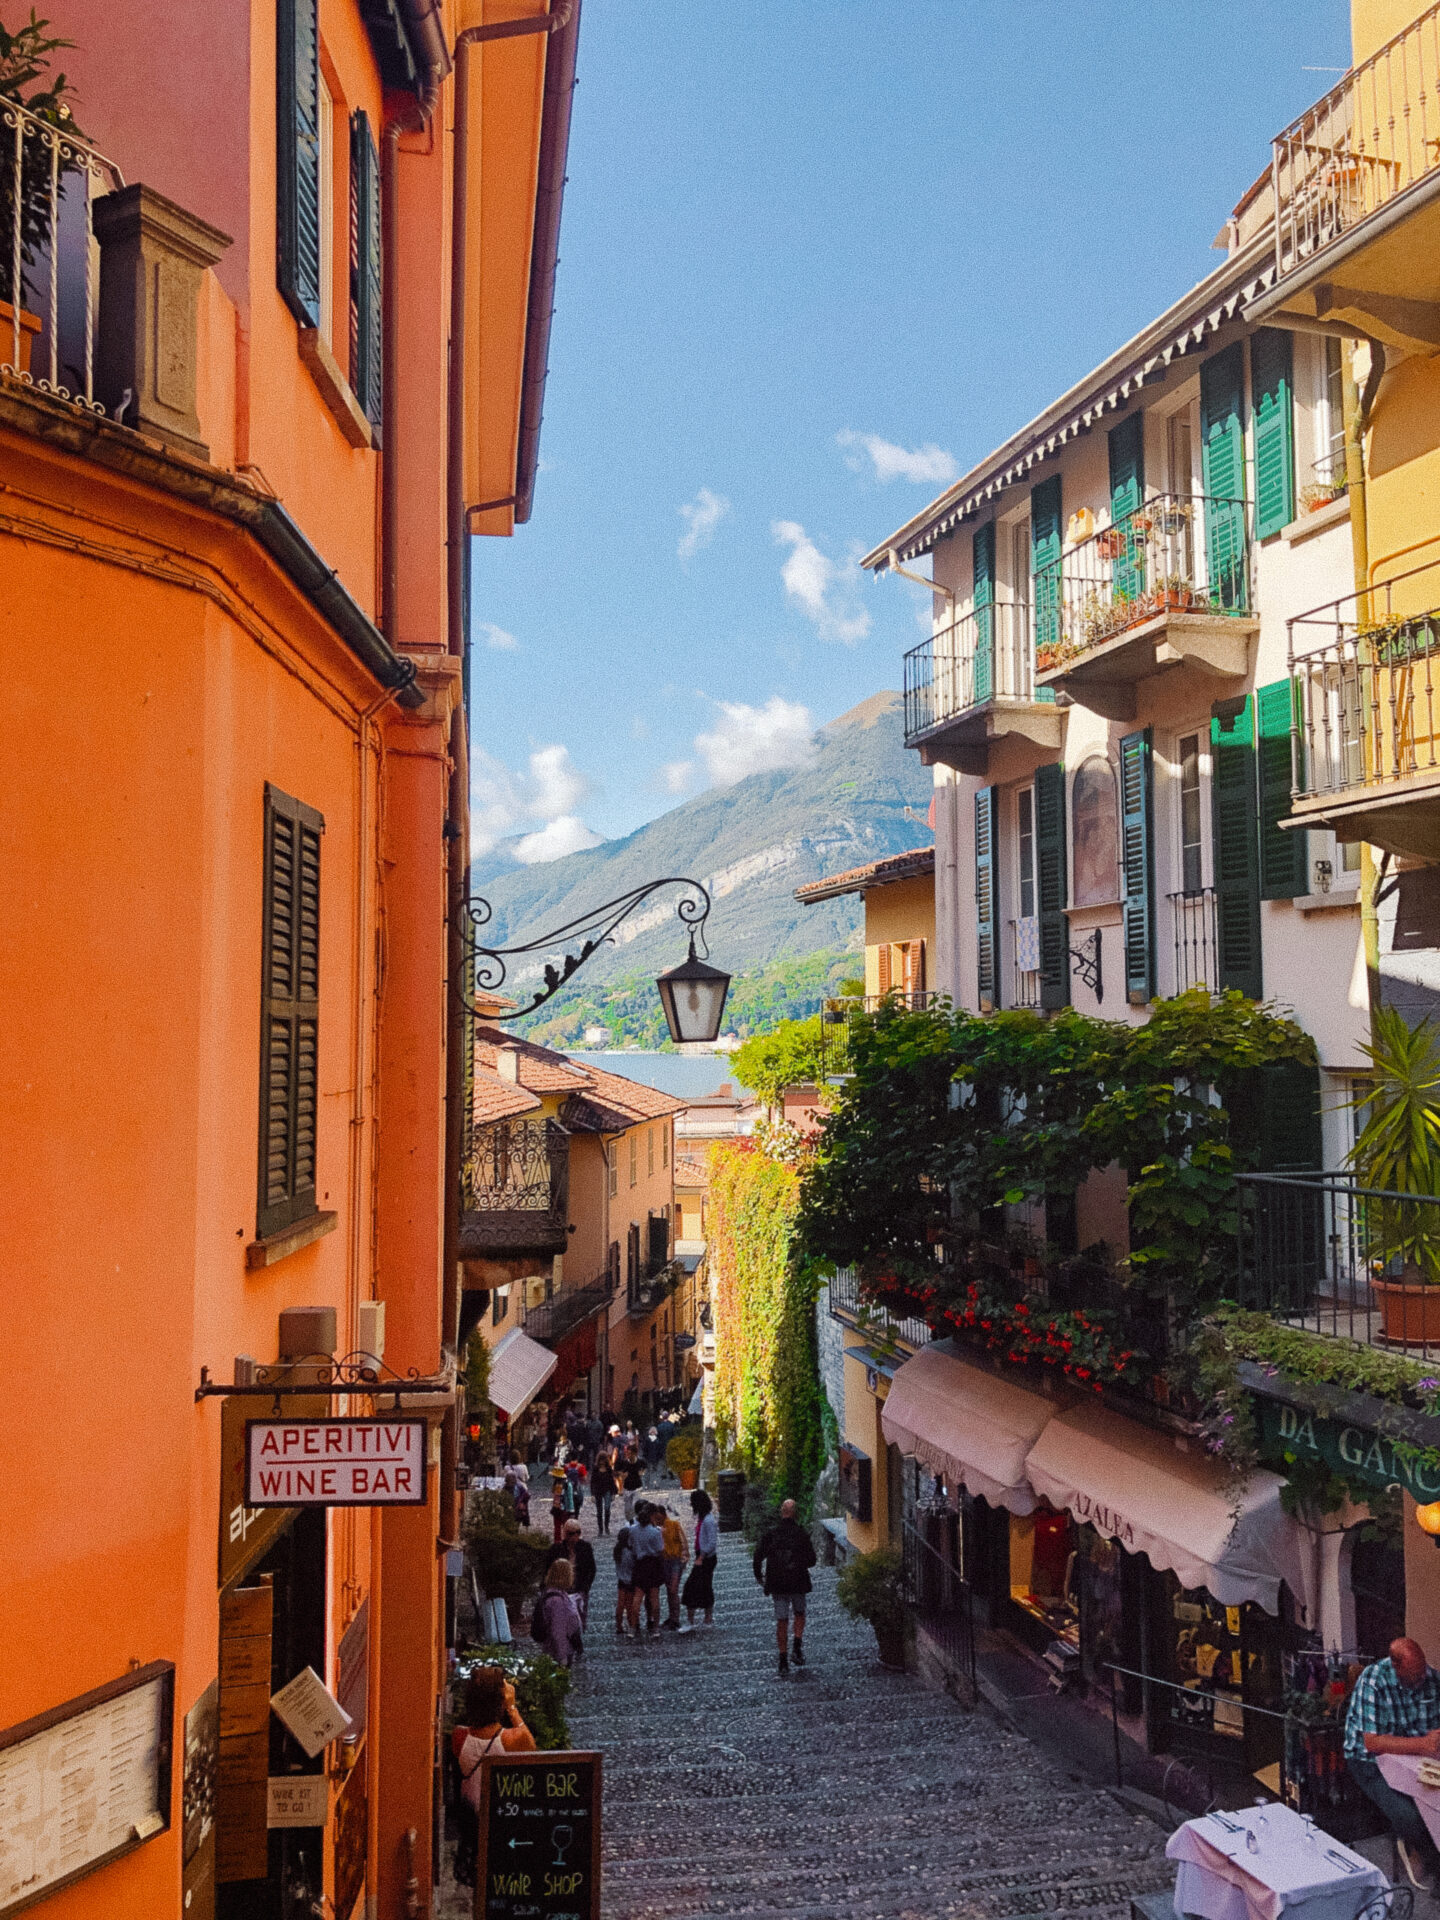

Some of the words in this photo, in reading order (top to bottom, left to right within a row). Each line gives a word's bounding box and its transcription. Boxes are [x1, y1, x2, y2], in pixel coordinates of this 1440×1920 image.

[260, 1426, 411, 1455] APERITIVI
[1278, 1406, 1318, 1450] DA
[259, 1469, 337, 1497] WINE
[352, 1467, 412, 1494] BAR
[1074, 1492, 1135, 1545] AZALEA
[543, 1871, 584, 1897] SHOP
